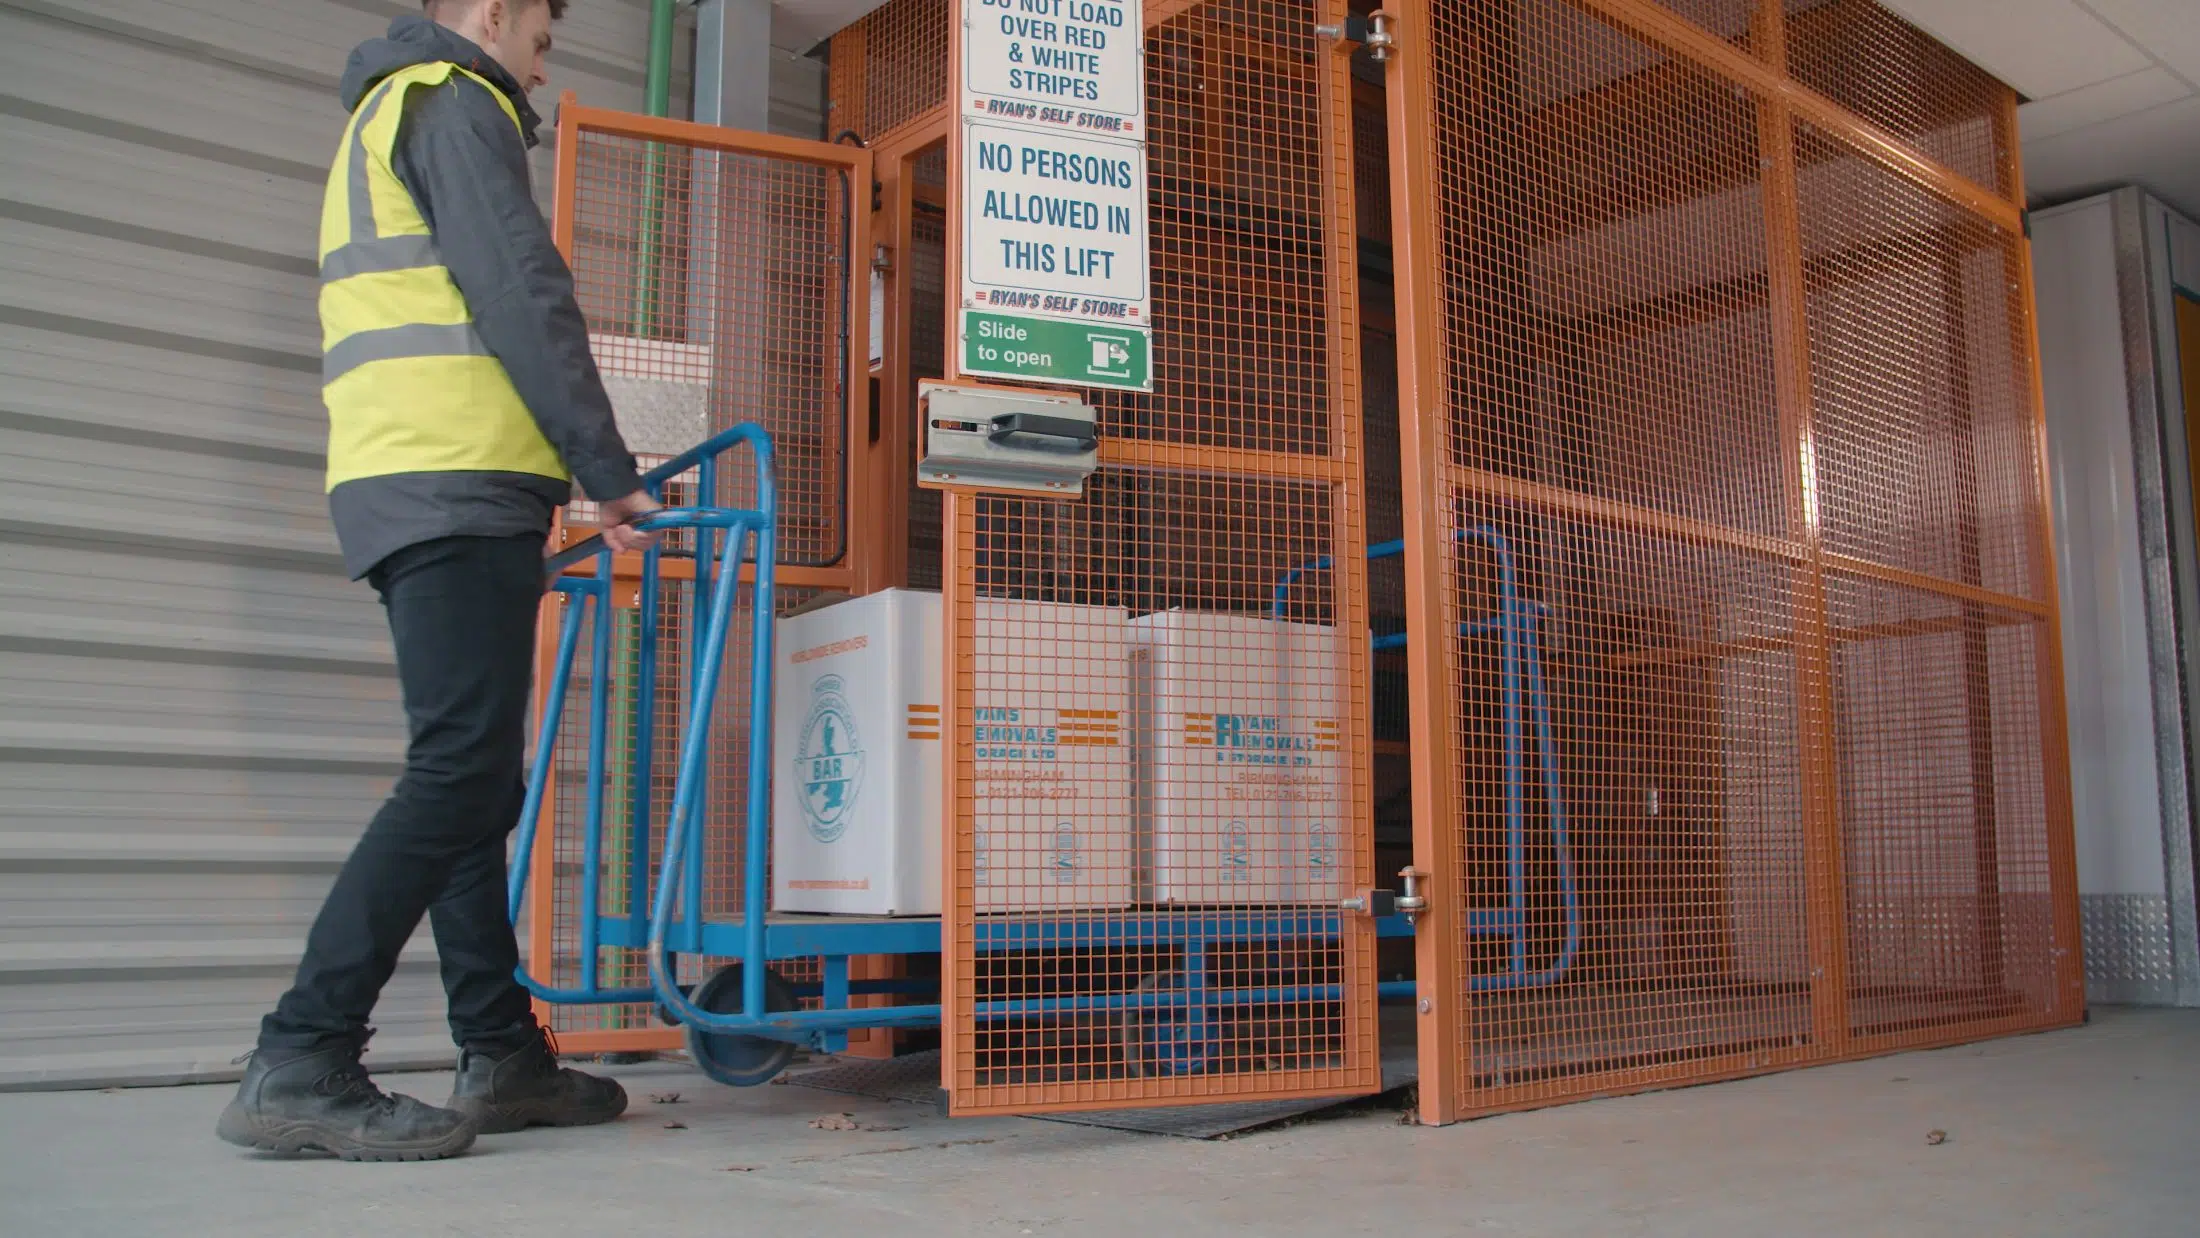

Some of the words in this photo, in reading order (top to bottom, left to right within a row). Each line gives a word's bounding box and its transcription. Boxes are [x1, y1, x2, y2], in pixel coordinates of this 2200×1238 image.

[1020, 0, 1062, 17] NOT
[1070, 1, 1123, 27] LOAD
[1000, 15, 1057, 42] OVER
[1065, 25, 1106, 50] RED
[1009, 42, 1023, 63] &
[1032, 45, 1100, 75] WHITE
[1010, 68, 1098, 101] STRIPES
[987, 99, 1037, 119] RYAN'S
[1039, 107, 1074, 123] SELF
[1077, 113, 1122, 132] STORE
[979, 141, 1012, 173] NO
[1022, 147, 1132, 189] PERSONS
[983, 189, 1099, 230] ALLOWED
[1108, 205, 1131, 235] IN
[1000, 239, 1055, 273] THIS
[1065, 246, 1115, 279] LIFT
[989, 289, 1040, 308] RYAN'S
[1043, 295, 1078, 312] SELF
[1081, 299, 1127, 318] STORE
[978, 320, 1028, 341] Slide
[977, 344, 998, 361] to
[1004, 349, 1052, 368] open
[975, 747, 1026, 758] ORAGE
[813, 758, 842, 781] BAR
